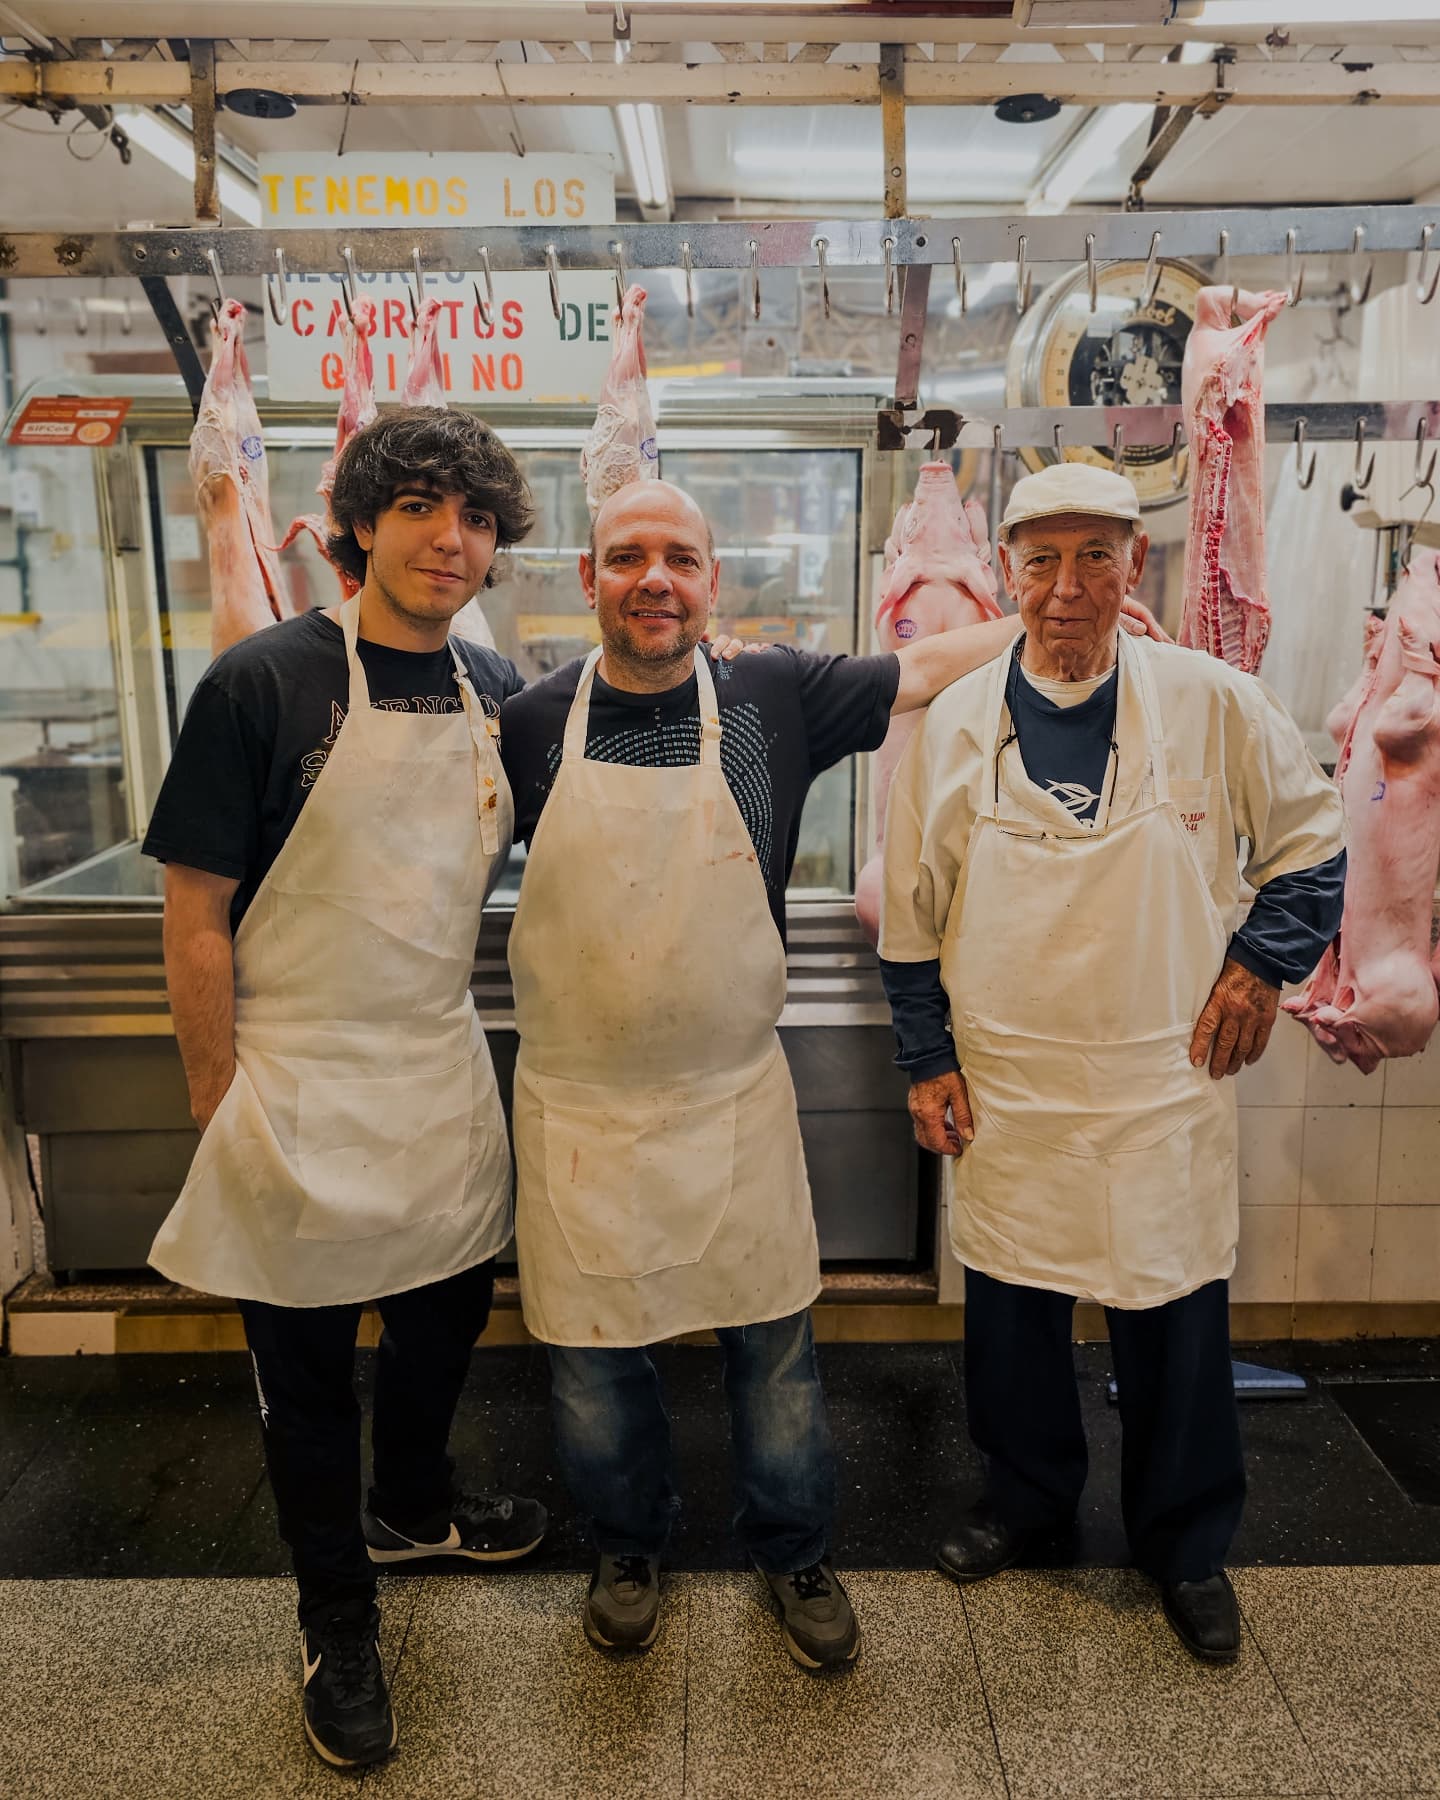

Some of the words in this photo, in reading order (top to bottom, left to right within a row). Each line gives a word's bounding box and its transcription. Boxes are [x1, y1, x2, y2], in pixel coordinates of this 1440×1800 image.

[262, 175, 468, 216] TENEMOS
[503, 177, 585, 217] LOS
[560, 303, 609, 341] DE
[321, 353, 523, 391] QIINO
